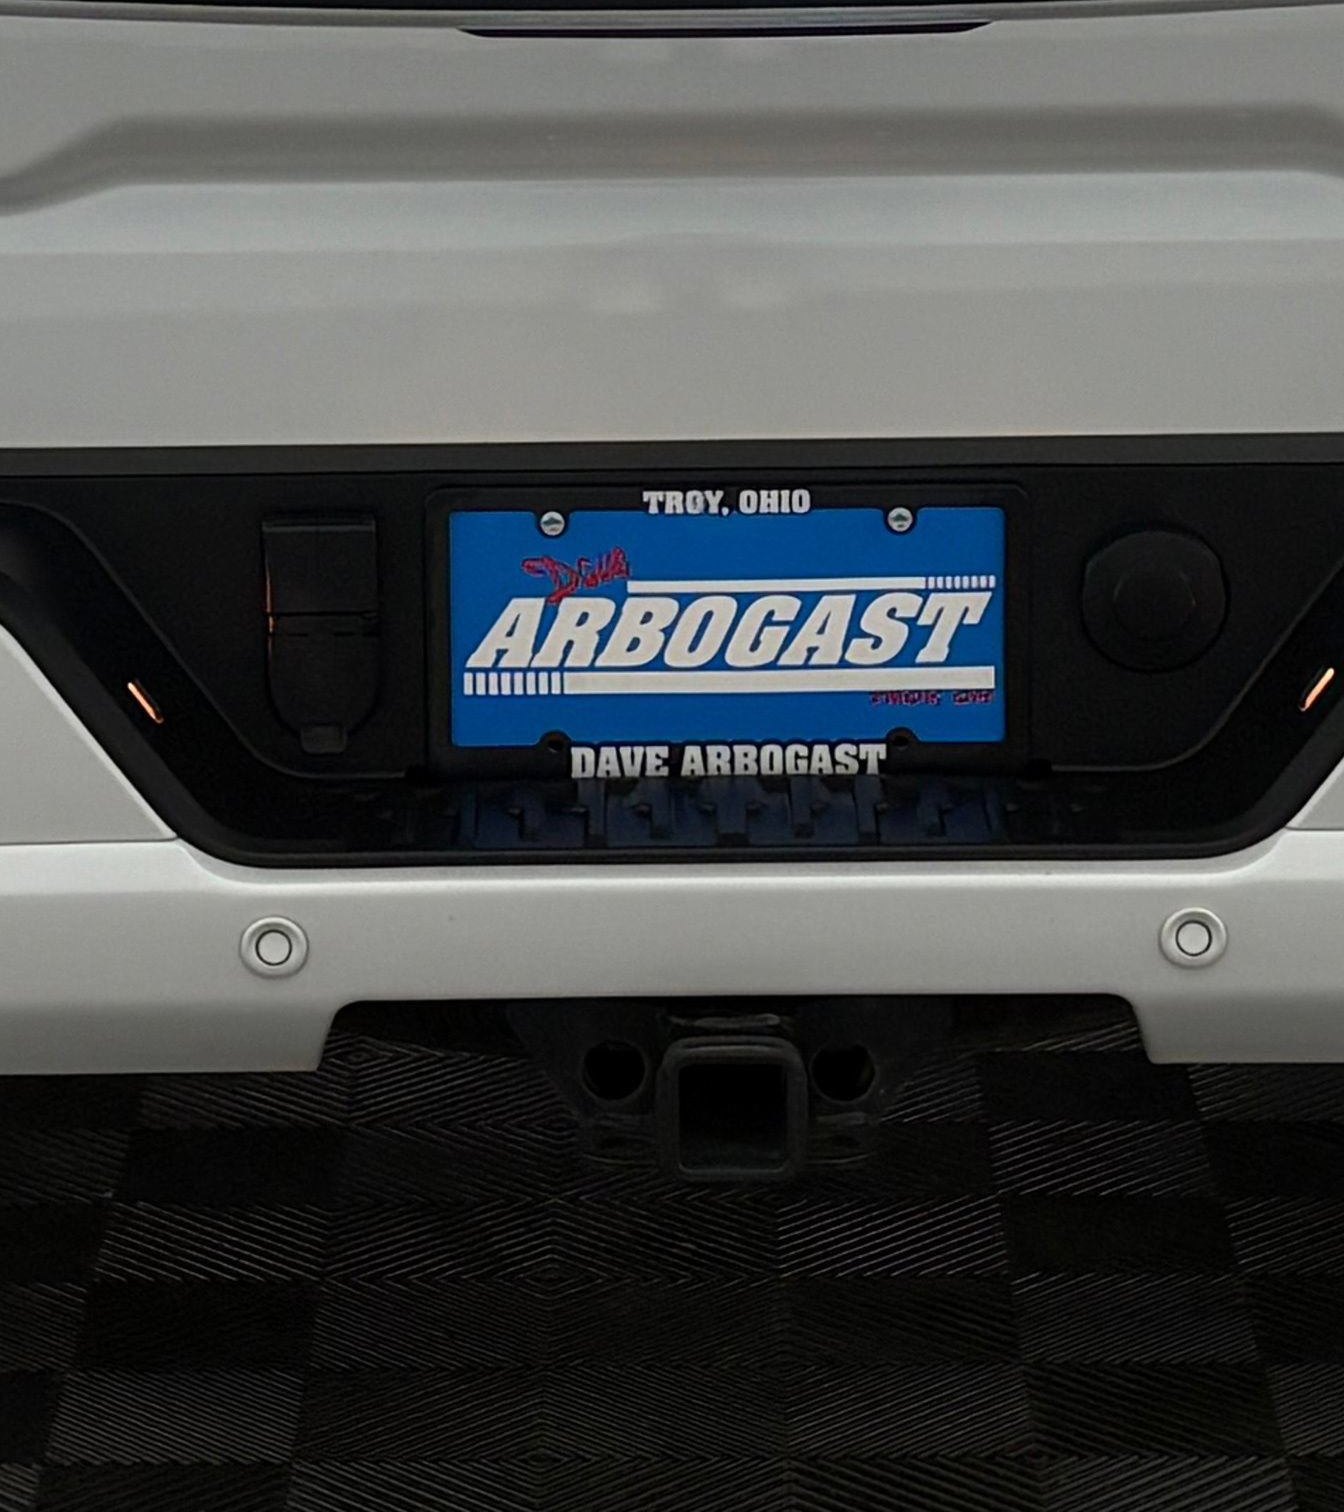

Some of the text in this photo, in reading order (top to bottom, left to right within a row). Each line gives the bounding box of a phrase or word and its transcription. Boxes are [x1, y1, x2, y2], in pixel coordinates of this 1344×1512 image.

[643, 489, 811, 516] TROY, OHIO
[466, 591, 992, 668] ARBOGAST
[571, 743, 887, 778] DAVE ARBOGAST
